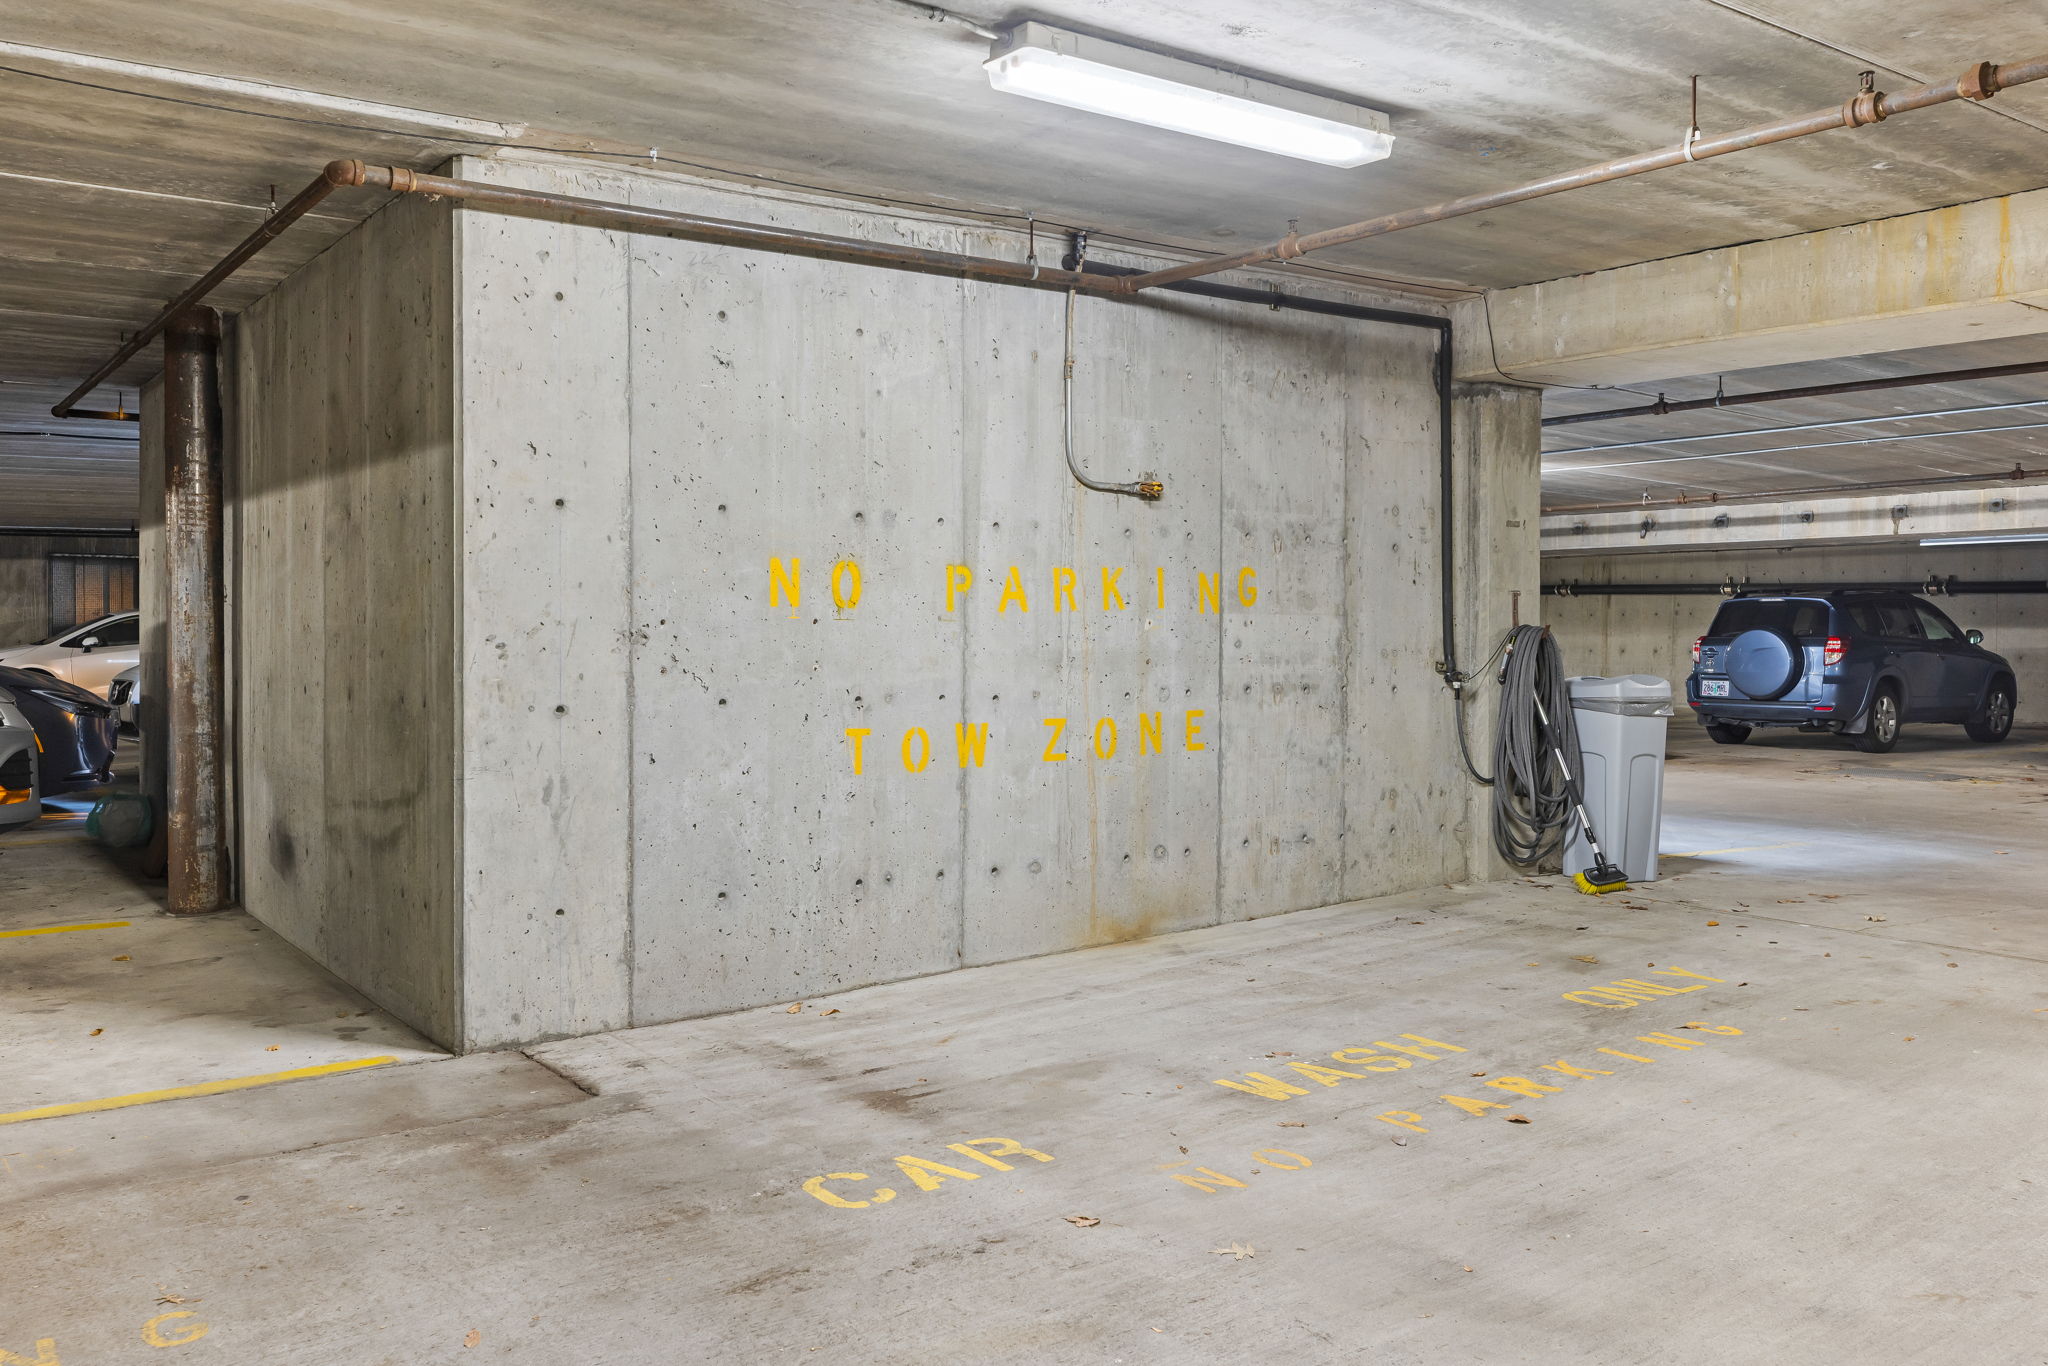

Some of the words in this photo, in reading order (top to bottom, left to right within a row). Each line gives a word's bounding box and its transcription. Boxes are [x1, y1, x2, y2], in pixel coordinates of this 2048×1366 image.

[769, 557, 862, 609] NO
[946, 564, 1258, 614] PARKING
[845, 722, 989, 775] TOW
[1042, 710, 1206, 762] ZONE
[802, 1137, 1055, 1209] CAR
[1213, 1033, 1468, 1101] WASH
[1561, 965, 1726, 1009] ONLY
[1170, 1148, 1313, 1193] NO
[1375, 1021, 1743, 1133] PARKING
